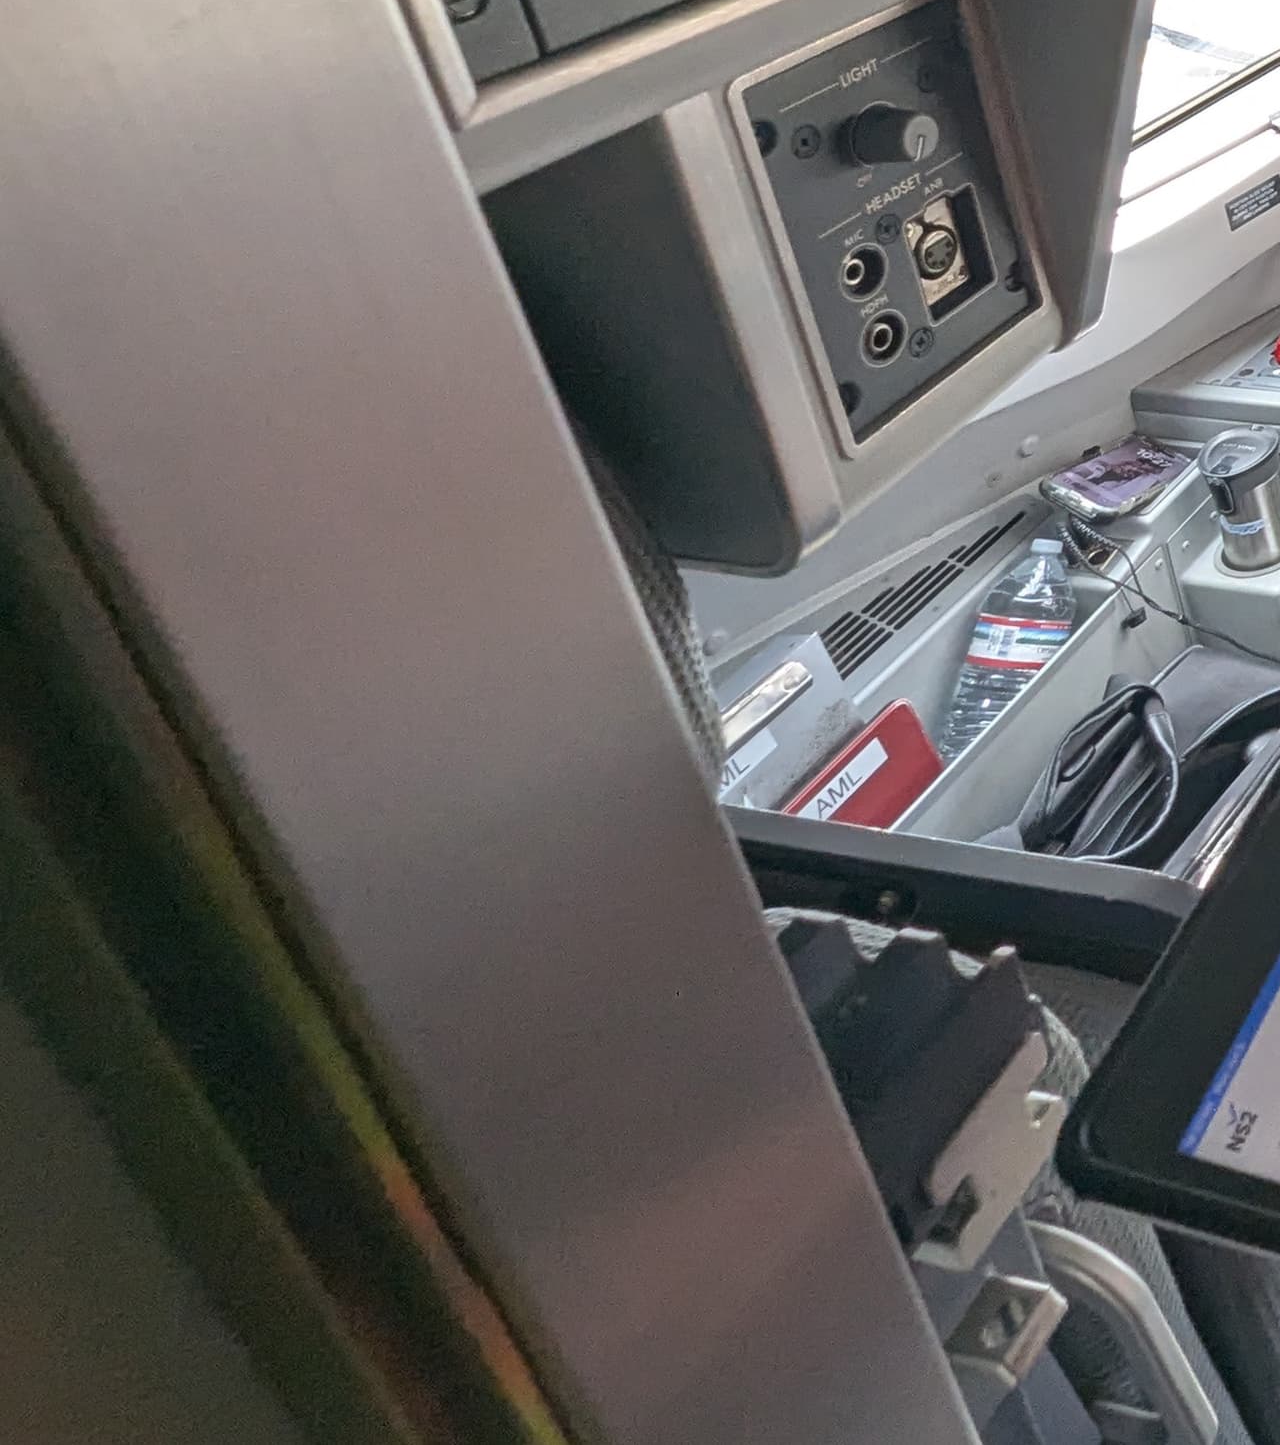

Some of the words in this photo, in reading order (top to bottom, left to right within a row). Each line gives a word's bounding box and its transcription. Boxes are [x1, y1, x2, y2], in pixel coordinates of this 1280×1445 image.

[839, 57, 879, 89] LIGHT
[864, 171, 922, 215] HEADSET
[843, 228, 865, 248] MIC
[720, 758, 751, 793] ML
[815, 771, 863, 819] AML
[1225, 1110, 1259, 1153] NS2
